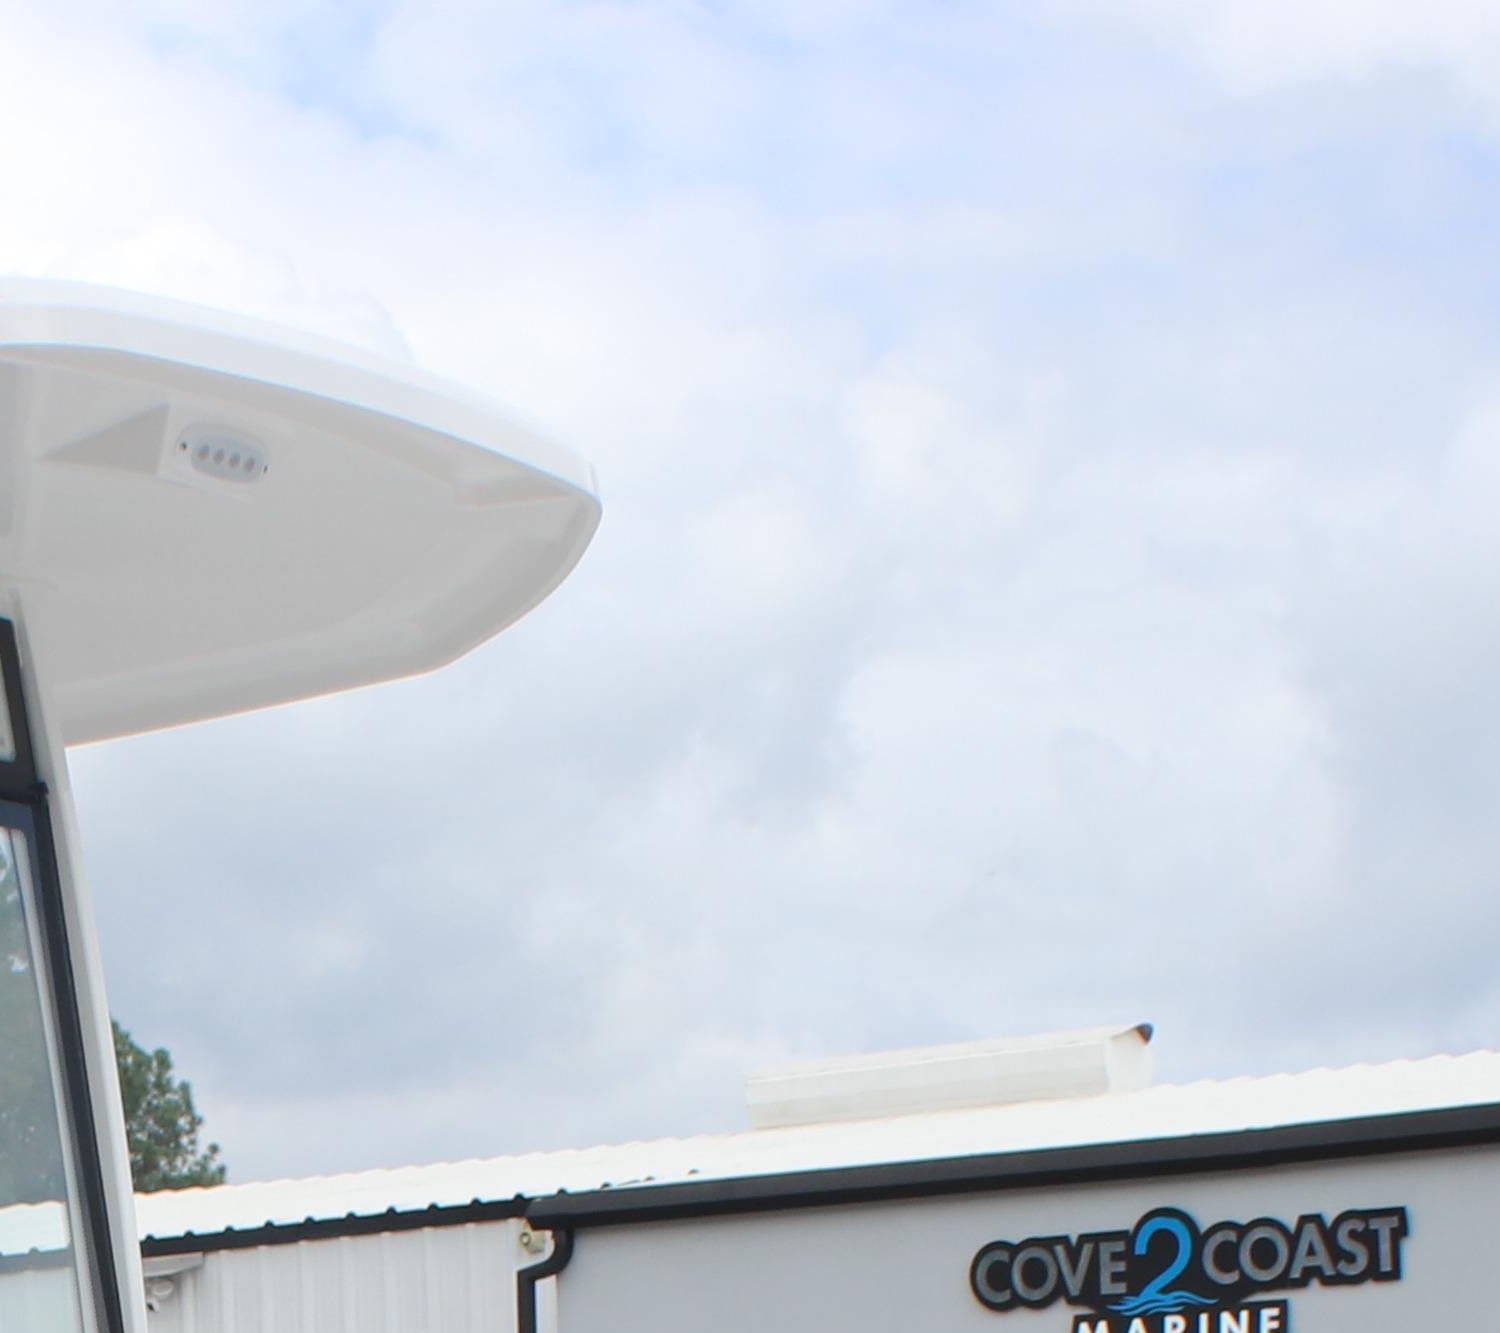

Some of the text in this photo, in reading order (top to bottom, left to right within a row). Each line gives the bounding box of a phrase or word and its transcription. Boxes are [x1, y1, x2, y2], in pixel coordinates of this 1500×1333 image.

[975, 1215, 1399, 1302] COVE 2 COAST
